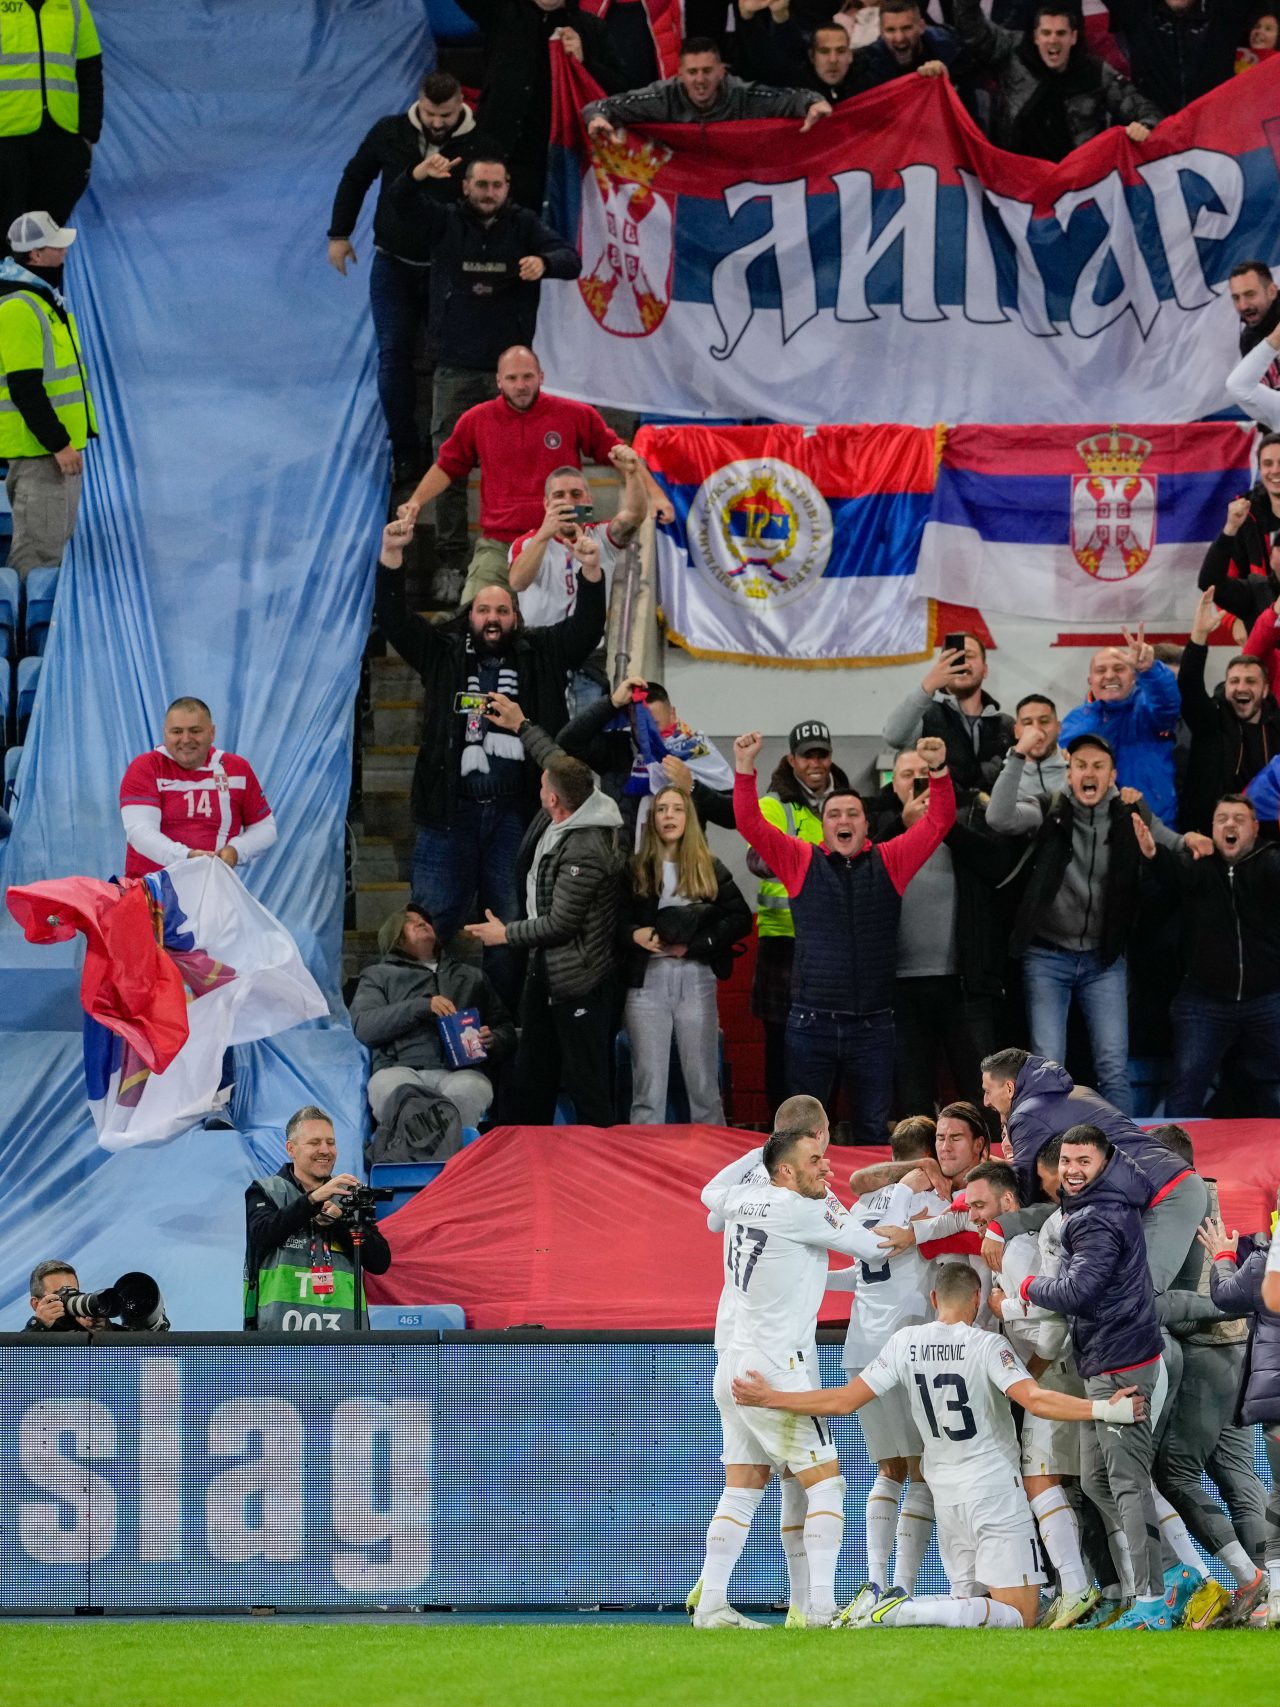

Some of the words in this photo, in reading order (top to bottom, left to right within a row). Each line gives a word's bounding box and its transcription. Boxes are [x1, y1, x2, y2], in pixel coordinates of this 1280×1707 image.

[796, 724, 829, 741] ICON
[183, 790, 213, 818] 14
[733, 1223, 769, 1293] 17
[399, 1316, 420, 1325] 465
[909, 1344, 919, 1363] S.
[920, 1341, 967, 1362] MITROVIĆ
[914, 1373, 978, 1442] 13
[18, 1356, 434, 1593] slag
